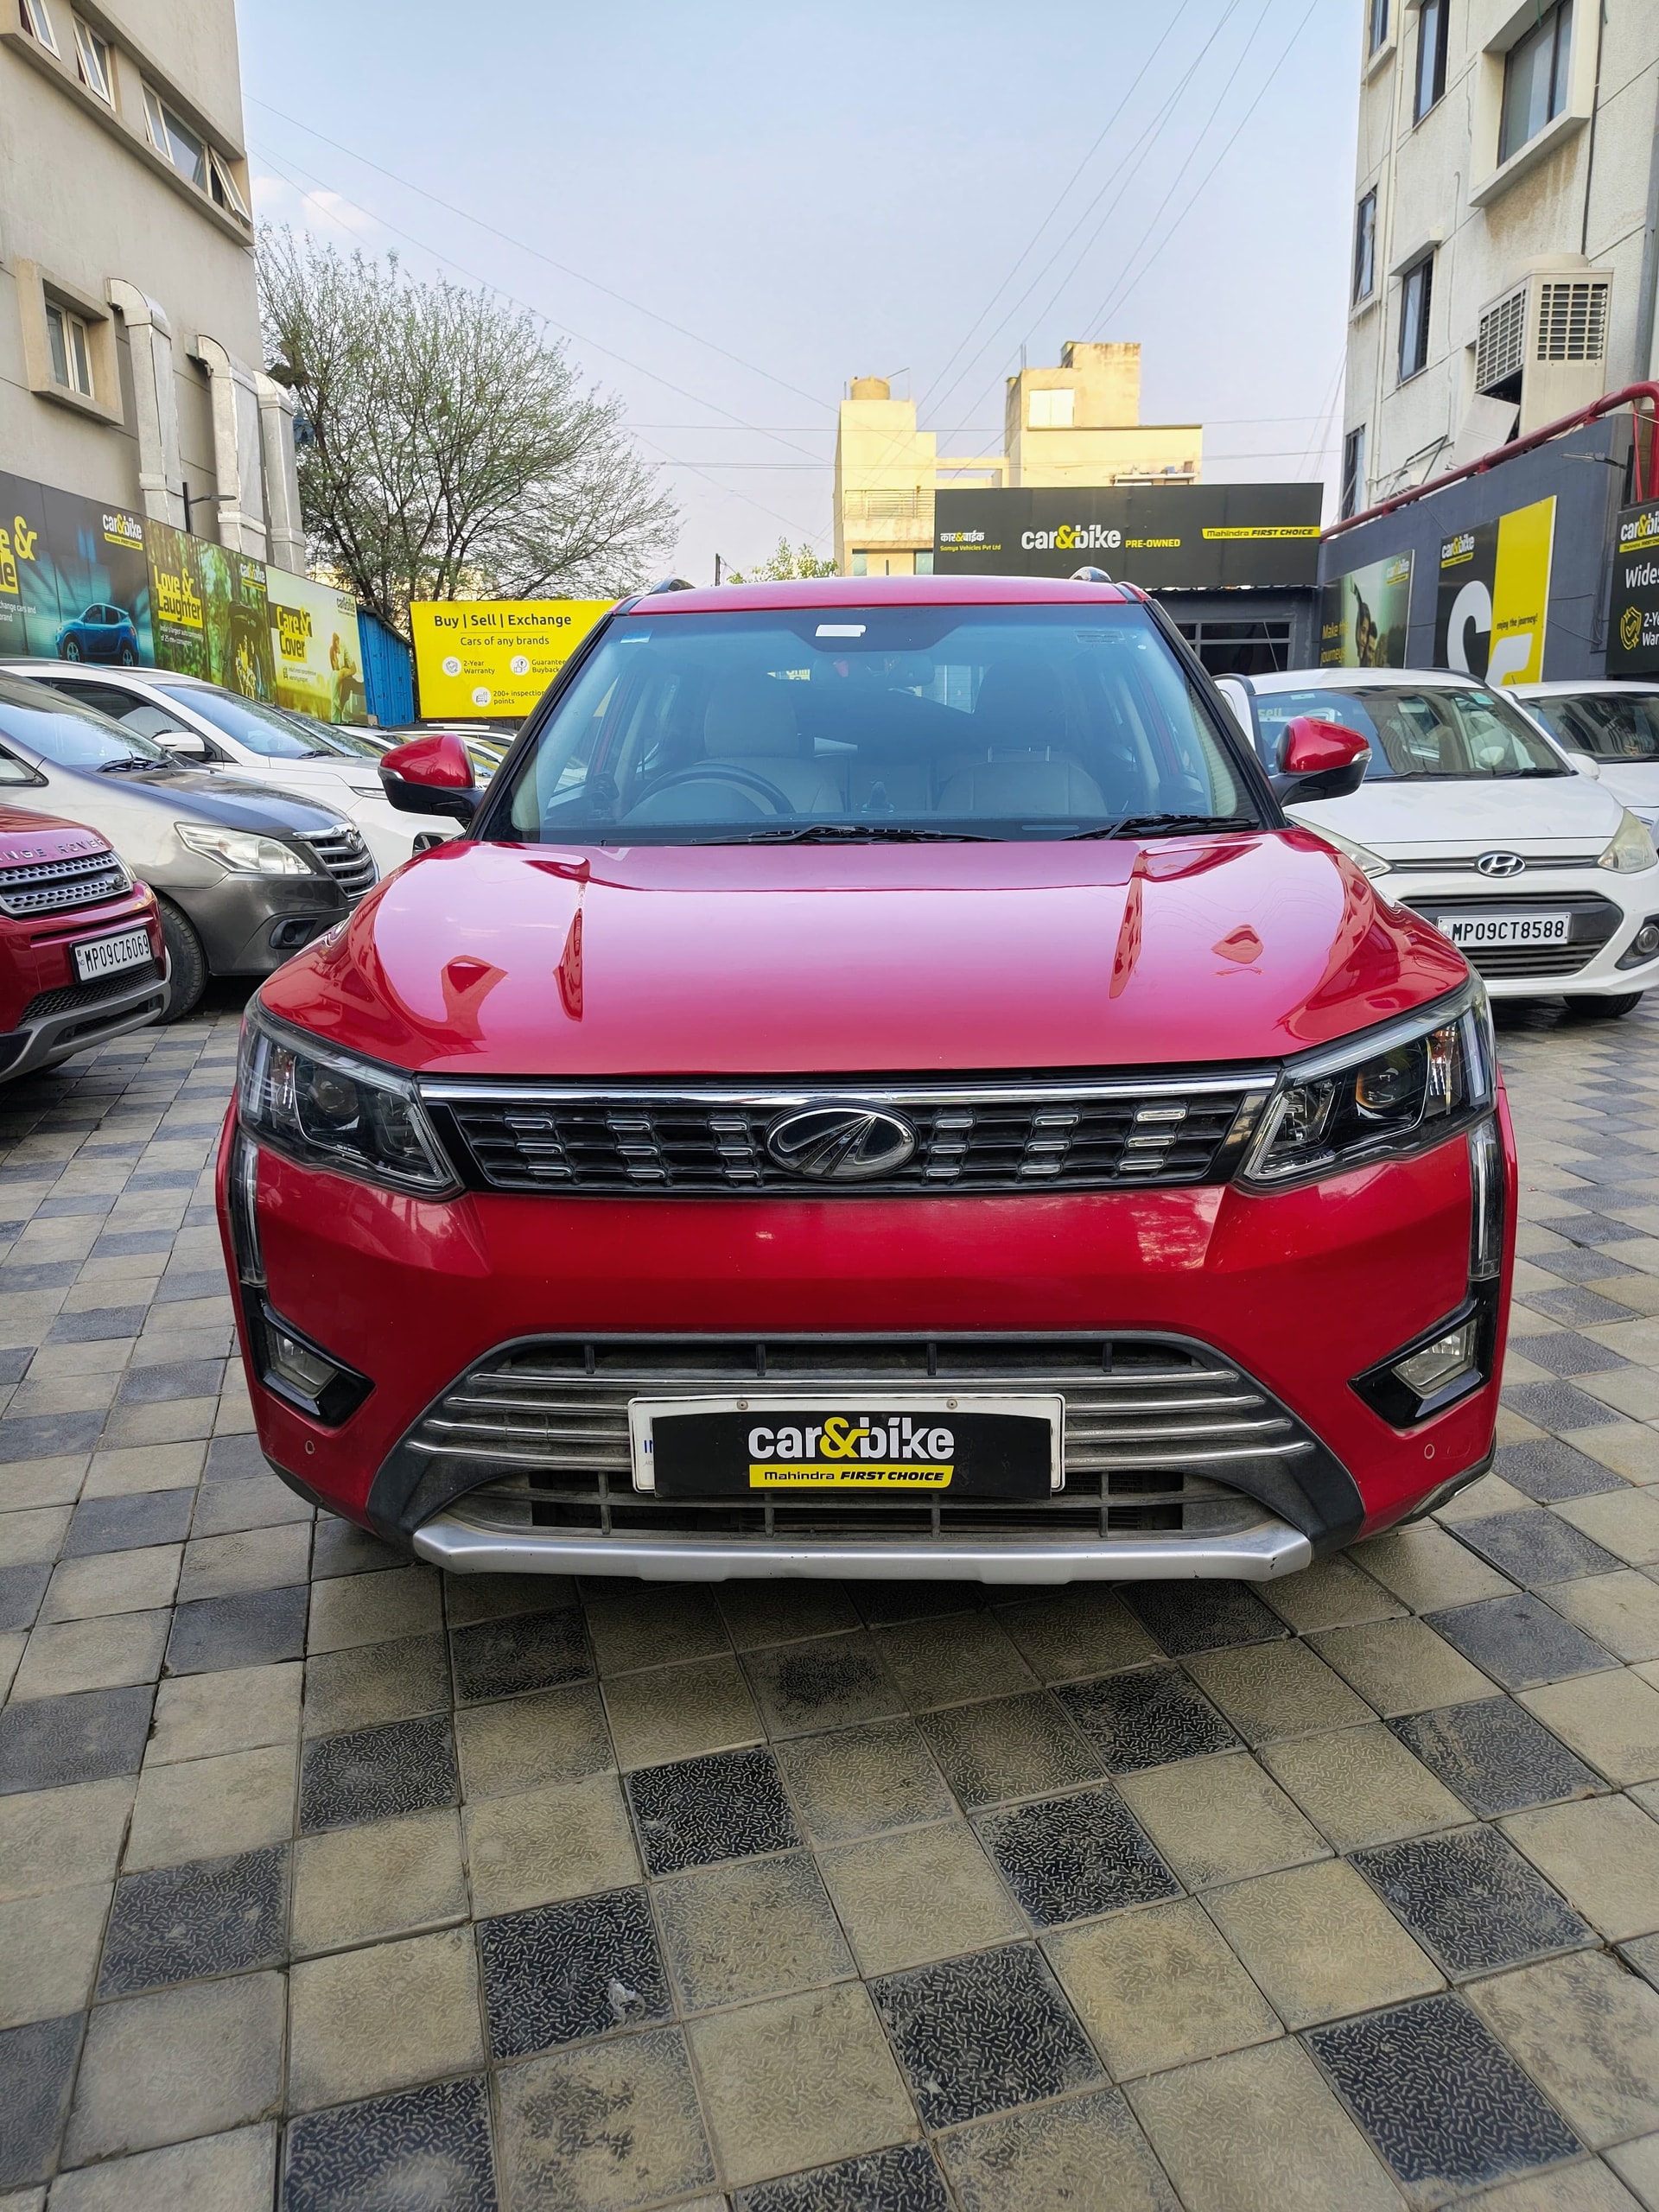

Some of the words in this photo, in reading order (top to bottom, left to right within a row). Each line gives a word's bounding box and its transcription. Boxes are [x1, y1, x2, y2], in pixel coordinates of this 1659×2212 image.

[103, 514, 142, 540] car&bike
[1021, 524, 1122, 550] car&bike
[1125, 539, 1180, 549] PRE-OWNED
[154, 565, 180, 594] Love
[181, 568, 194, 598] &
[157, 591, 202, 621] Laughter
[276, 606, 300, 633] Care
[435, 615, 459, 628] Buy
[471, 614, 496, 626] Sell
[508, 613, 571, 627] Exchange
[279, 630, 305, 658] Cover
[461, 637, 481, 645] Cars
[485, 636, 495, 645] of
[497, 638, 513, 647] any
[517, 636, 550, 645] brands
[55, 838, 104, 855] ROVER
[1452, 920, 1565, 941] MP09CT8588
[84, 934, 149, 972] MP09CZ6069
[748, 1416, 955, 1459] car&bike
[764, 1471, 836, 1480] Mahindra
[840, 1471, 887, 1481] FIRST
[887, 1471, 945, 1481] CHOICE
